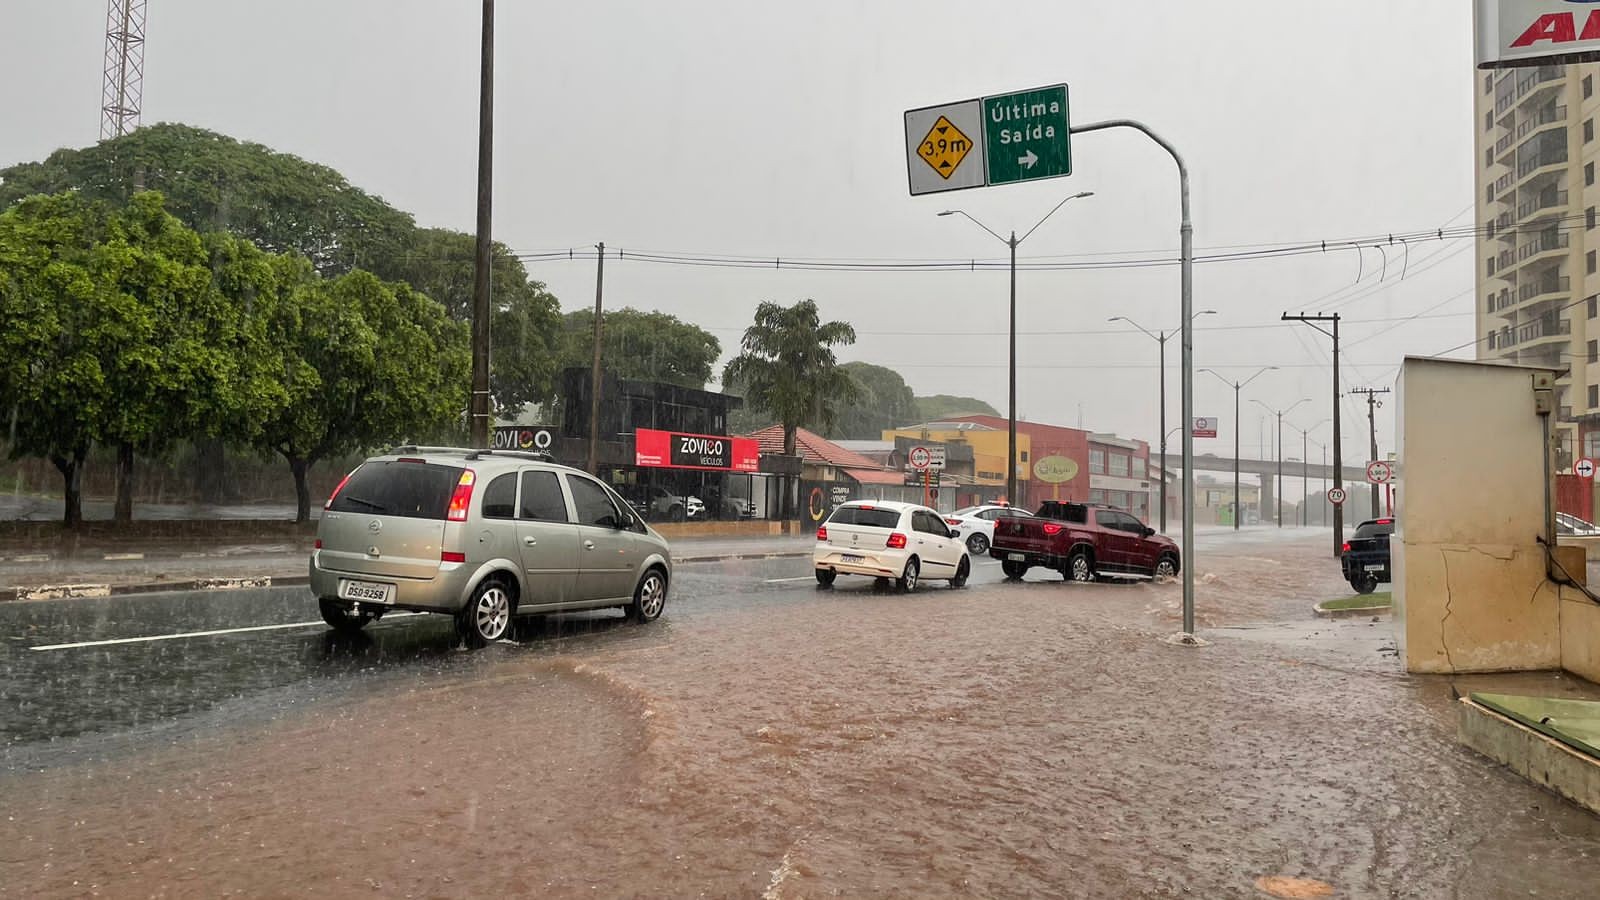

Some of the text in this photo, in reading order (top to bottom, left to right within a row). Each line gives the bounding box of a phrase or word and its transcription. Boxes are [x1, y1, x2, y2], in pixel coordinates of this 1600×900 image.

[991, 101, 1060, 122] Última
[1000, 123, 1056, 144] Saída
[680, 437, 723, 455] ZOVICO
